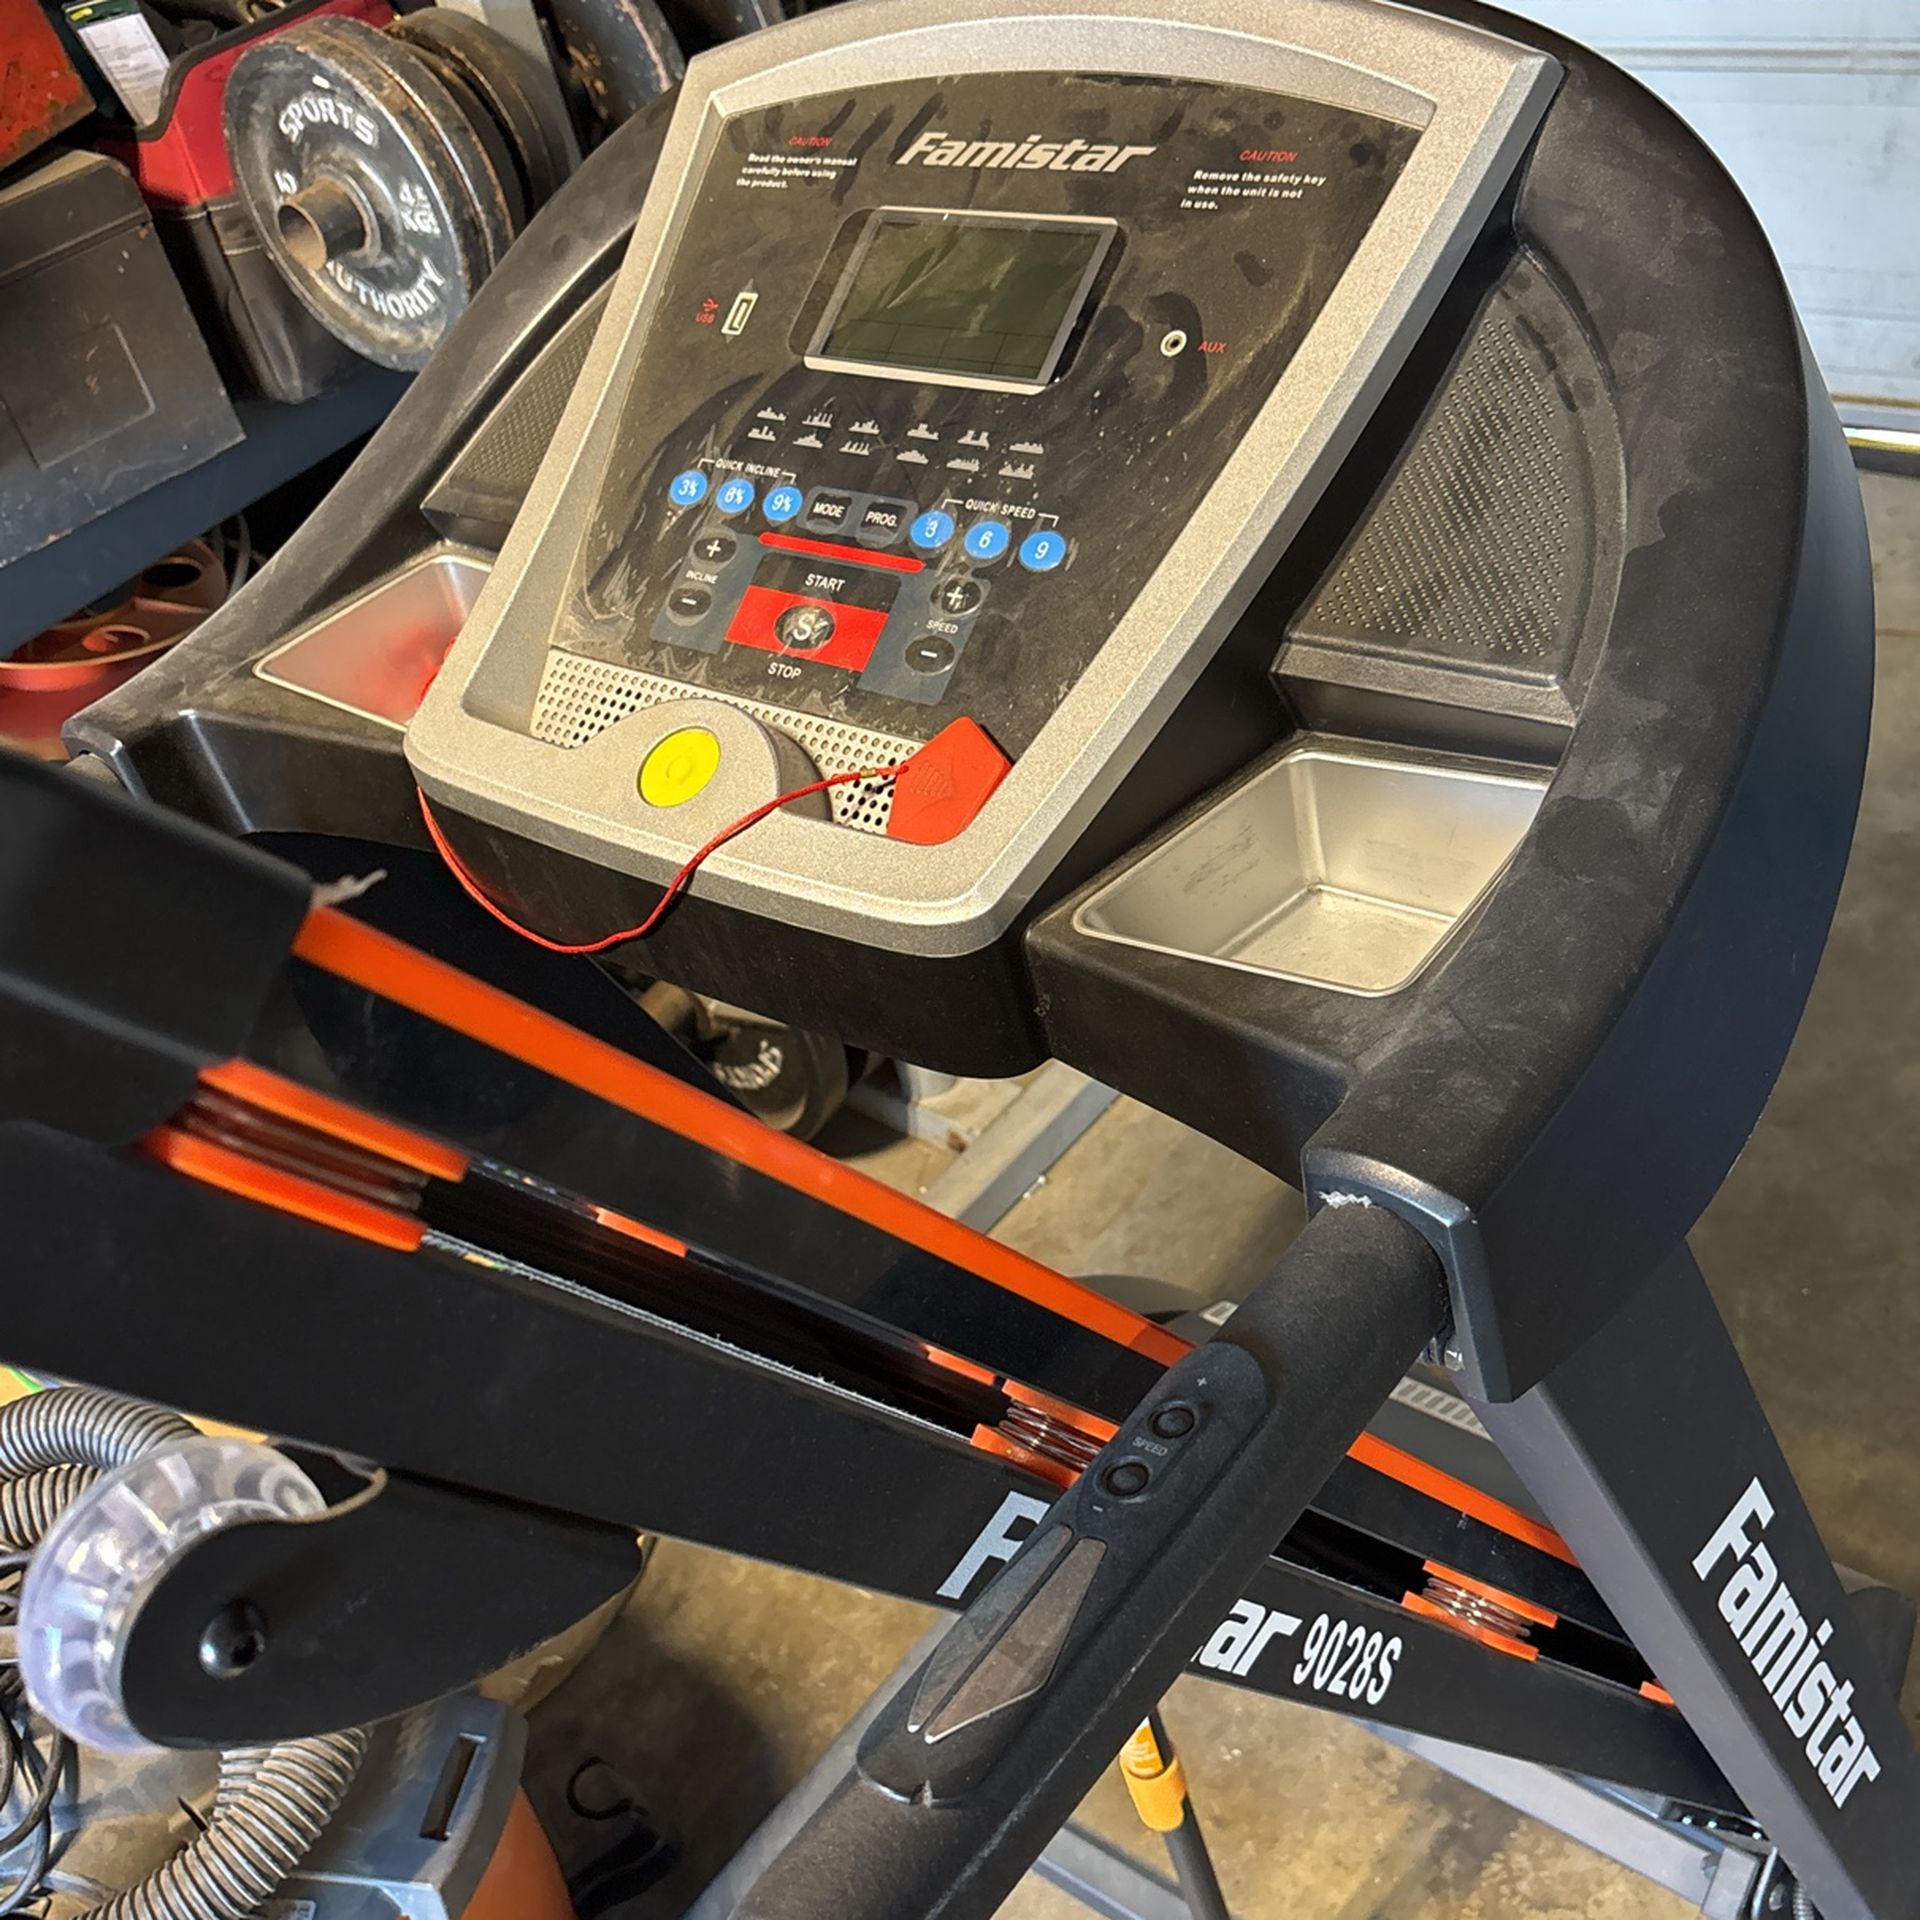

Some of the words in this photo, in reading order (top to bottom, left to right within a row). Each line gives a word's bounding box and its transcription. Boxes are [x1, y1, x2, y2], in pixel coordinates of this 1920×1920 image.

[279, 96, 379, 146] SPORTS
[788, 136, 832, 147] CAUTION
[747, 153, 771, 163] Read
[771, 154, 786, 164] the
[823, 157, 858, 167] manual
[895, 131, 1157, 173] Famistar
[1239, 150, 1297, 163] CAUTION
[741, 166, 780, 177] carefully
[781, 168, 811, 178] before
[811, 170, 837, 180] using
[1193, 169, 1240, 182] Remove
[1241, 172, 1261, 182] the
[1262, 173, 1302, 186] safety
[1302, 174, 1327, 187] key
[736, 178, 751, 187] the
[1187, 185, 1219, 195] when
[1220, 185, 1241, 196] the
[1242, 186, 1267, 197] unit
[1267, 187, 1279, 198] is
[1280, 189, 1303, 199] not
[1180, 198, 1192, 209] in
[1193, 200, 1219, 210] use.
[695, 311, 716, 324] USB
[1197, 340, 1227, 353] AUX
[714, 457, 744, 470] QUICK
[744, 462, 783, 478] INCLINE
[677, 478, 699, 497] 3%
[770, 494, 794, 513] 9%
[812, 502, 846, 518] MODE
[964, 498, 998, 513] QUICK
[1000, 503, 1037, 520] SPEED
[865, 510, 898, 528] PROG.
[924, 520, 939, 539] 3
[978, 530, 994, 549] 6
[1034, 541, 1050, 560] 9
[685, 570, 720, 585] INCLINE
[804, 573, 846, 592] START
[926, 619, 959, 634] SPEED
[767, 661, 802, 680] STOP
[1132, 1436, 1169, 1457] SPEED
[1691, 1476, 1882, 1809] Famistar
[1293, 1613, 1403, 1705] 9028S
